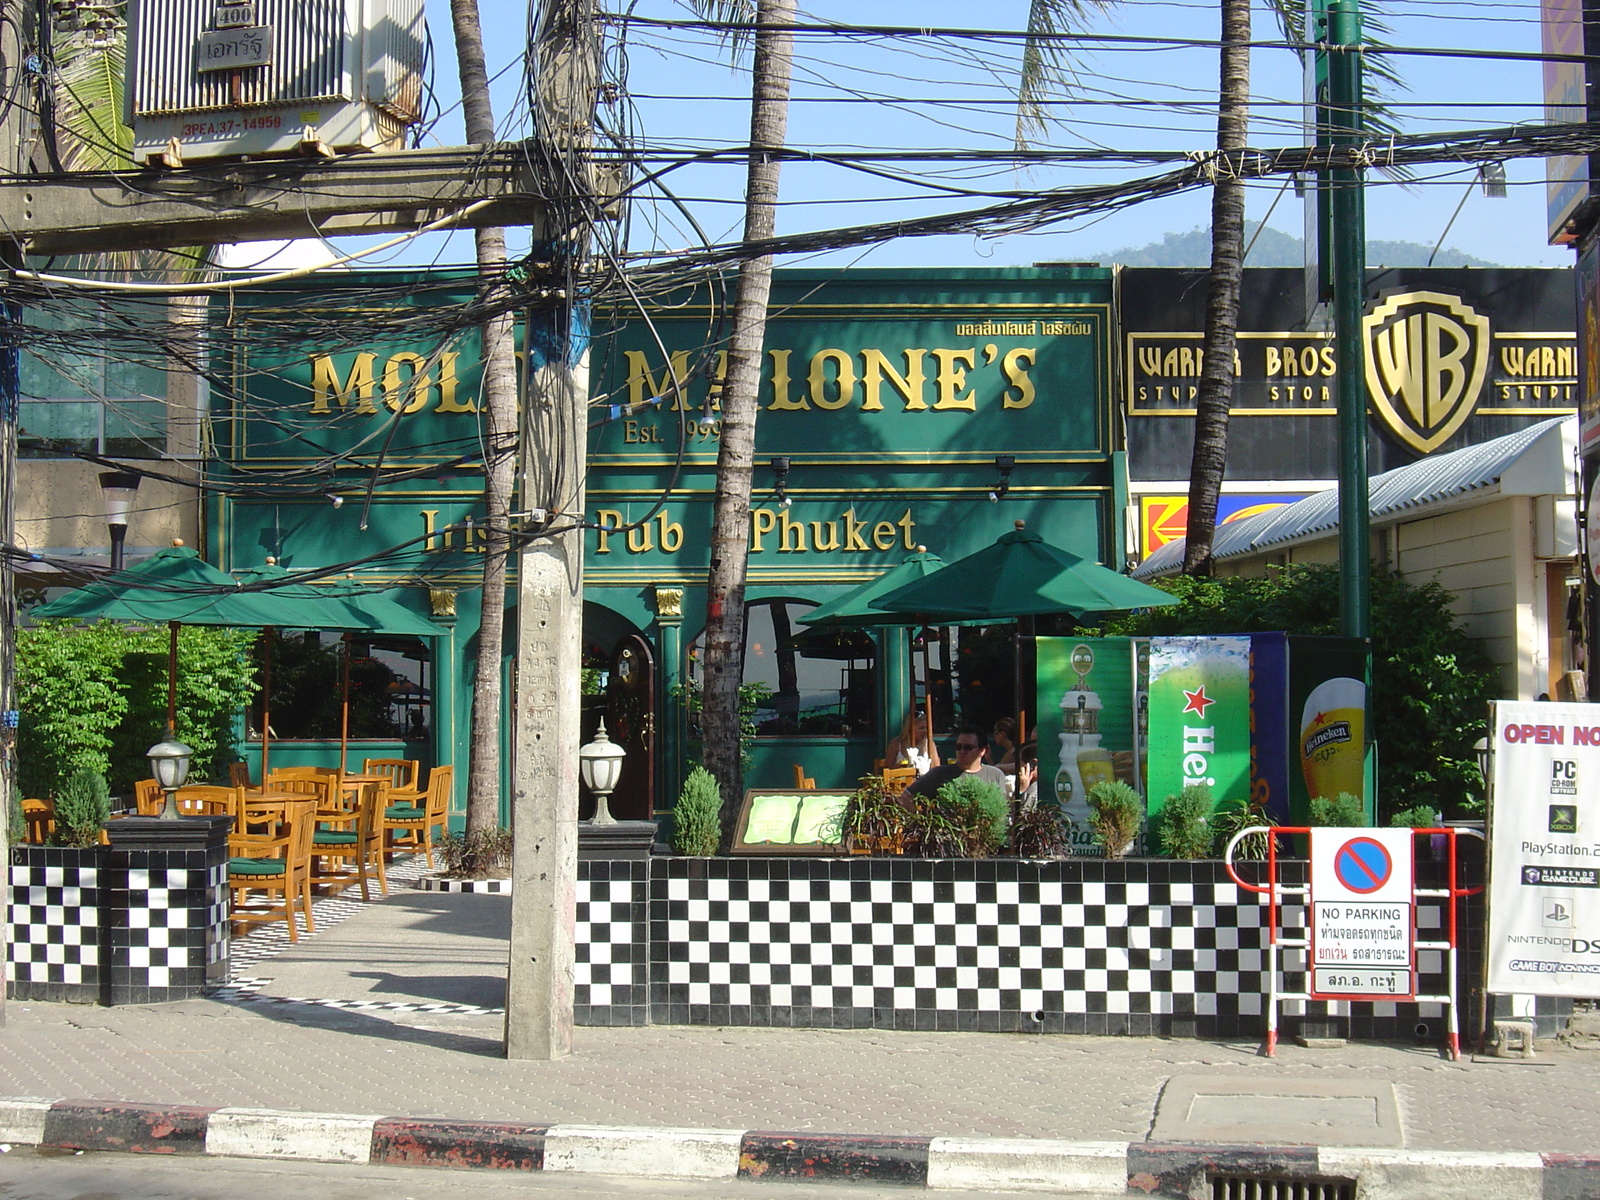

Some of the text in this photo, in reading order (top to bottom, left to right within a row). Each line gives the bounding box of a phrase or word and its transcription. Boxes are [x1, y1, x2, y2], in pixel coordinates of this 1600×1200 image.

[219, 8, 252, 24] 400
[1138, 346, 1241, 377] WARR
[1377, 311, 1470, 429] WB
[1501, 346, 1578, 376] WARN
[309, 351, 525, 414] MOL
[1139, 386, 1330, 400] STUD STOR
[1502, 385, 1571, 400] STUDI
[624, 420, 665, 443] Est.
[421, 507, 917, 553] Iris Pub Phuket
[1305, 727, 1347, 754] Heineken
[1504, 723, 1600, 747] OPEN NO
[1552, 760, 1576, 779] PC
[1322, 908, 1401, 920] NO PARKING
[1319, 941, 1405, 960] ยกเว้น รถสาธารณะ
[1508, 935, 1600, 954] NINTENDO DS
[1509, 960, 1600, 973] GAME BOY ADVANC
[1370, 971, 1397, 993] กะทู้
